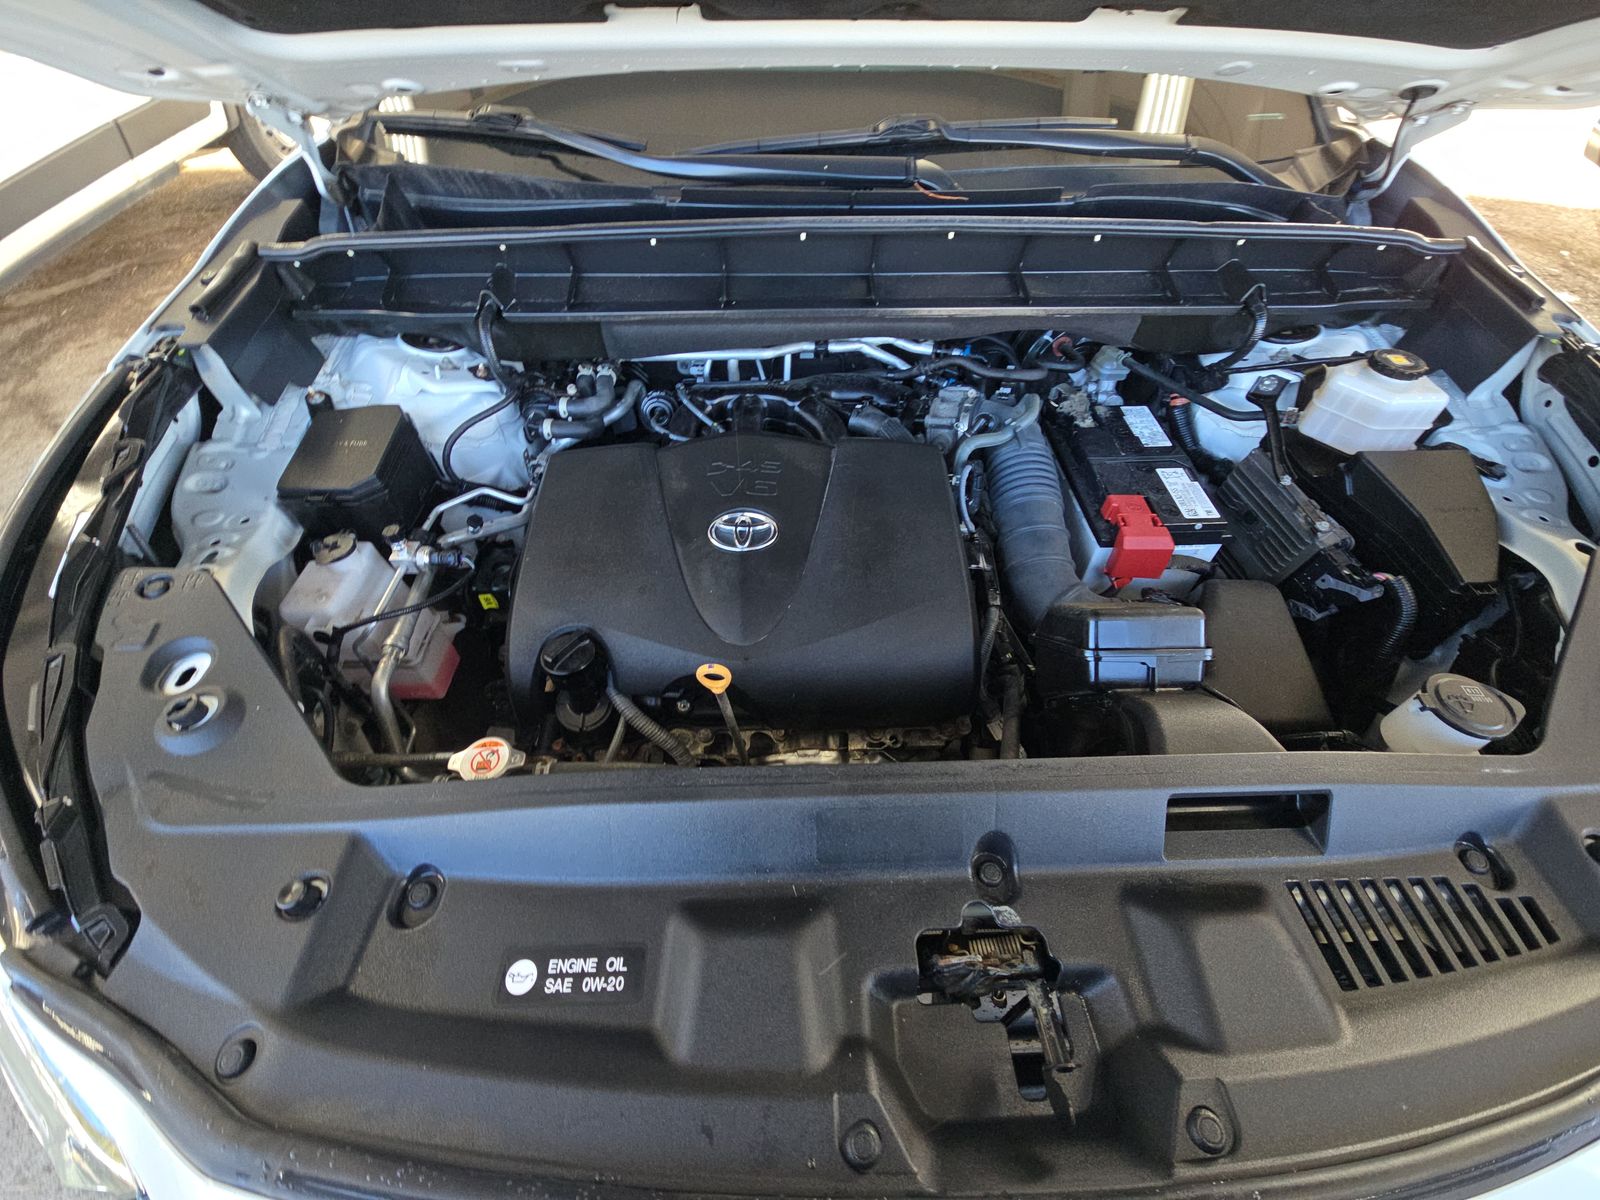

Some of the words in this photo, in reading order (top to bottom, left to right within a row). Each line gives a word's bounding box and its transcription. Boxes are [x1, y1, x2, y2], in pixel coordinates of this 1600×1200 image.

[547, 957, 598, 974] ENGINE
[606, 956, 628, 972] OIL
[544, 977, 574, 994] SAE
[582, 975, 625, 993] 0W-20
